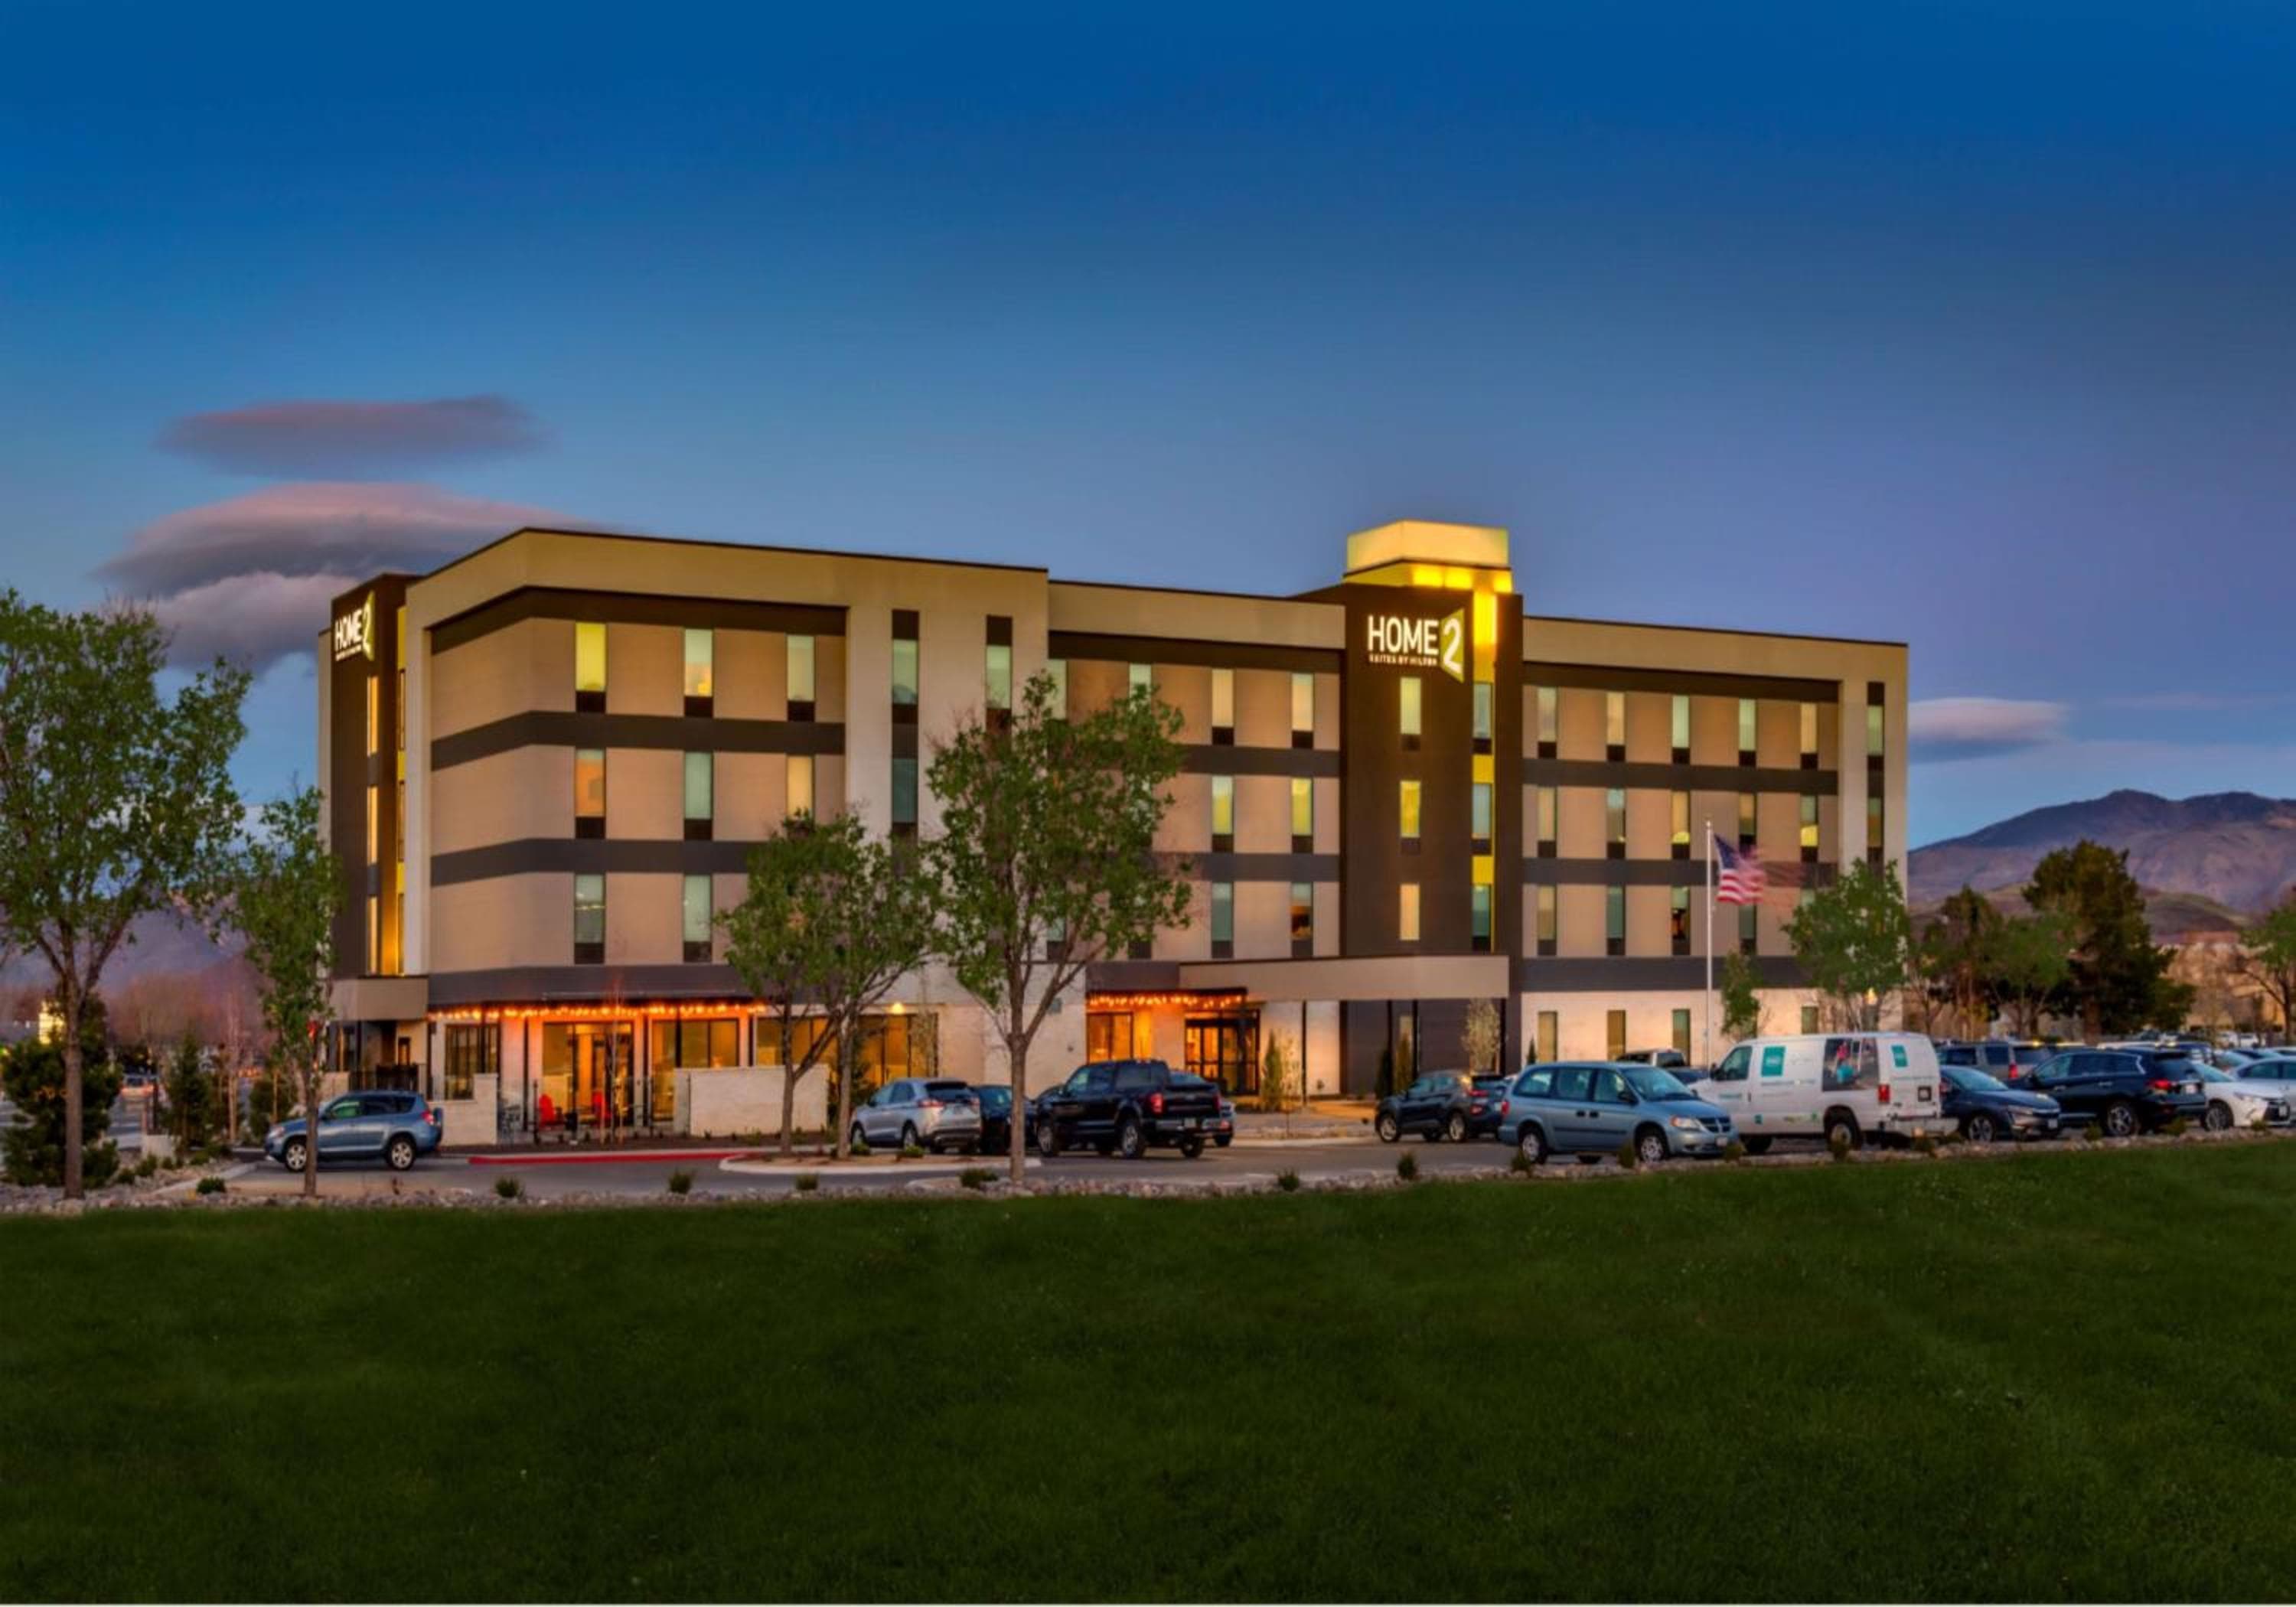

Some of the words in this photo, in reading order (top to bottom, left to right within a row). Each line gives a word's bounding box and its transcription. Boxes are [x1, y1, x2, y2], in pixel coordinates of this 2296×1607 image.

[334, 608, 362, 652] HOME
[363, 602, 371, 655] 2
[1368, 615, 1439, 655] HOME
[1443, 618, 1463, 674] 2
